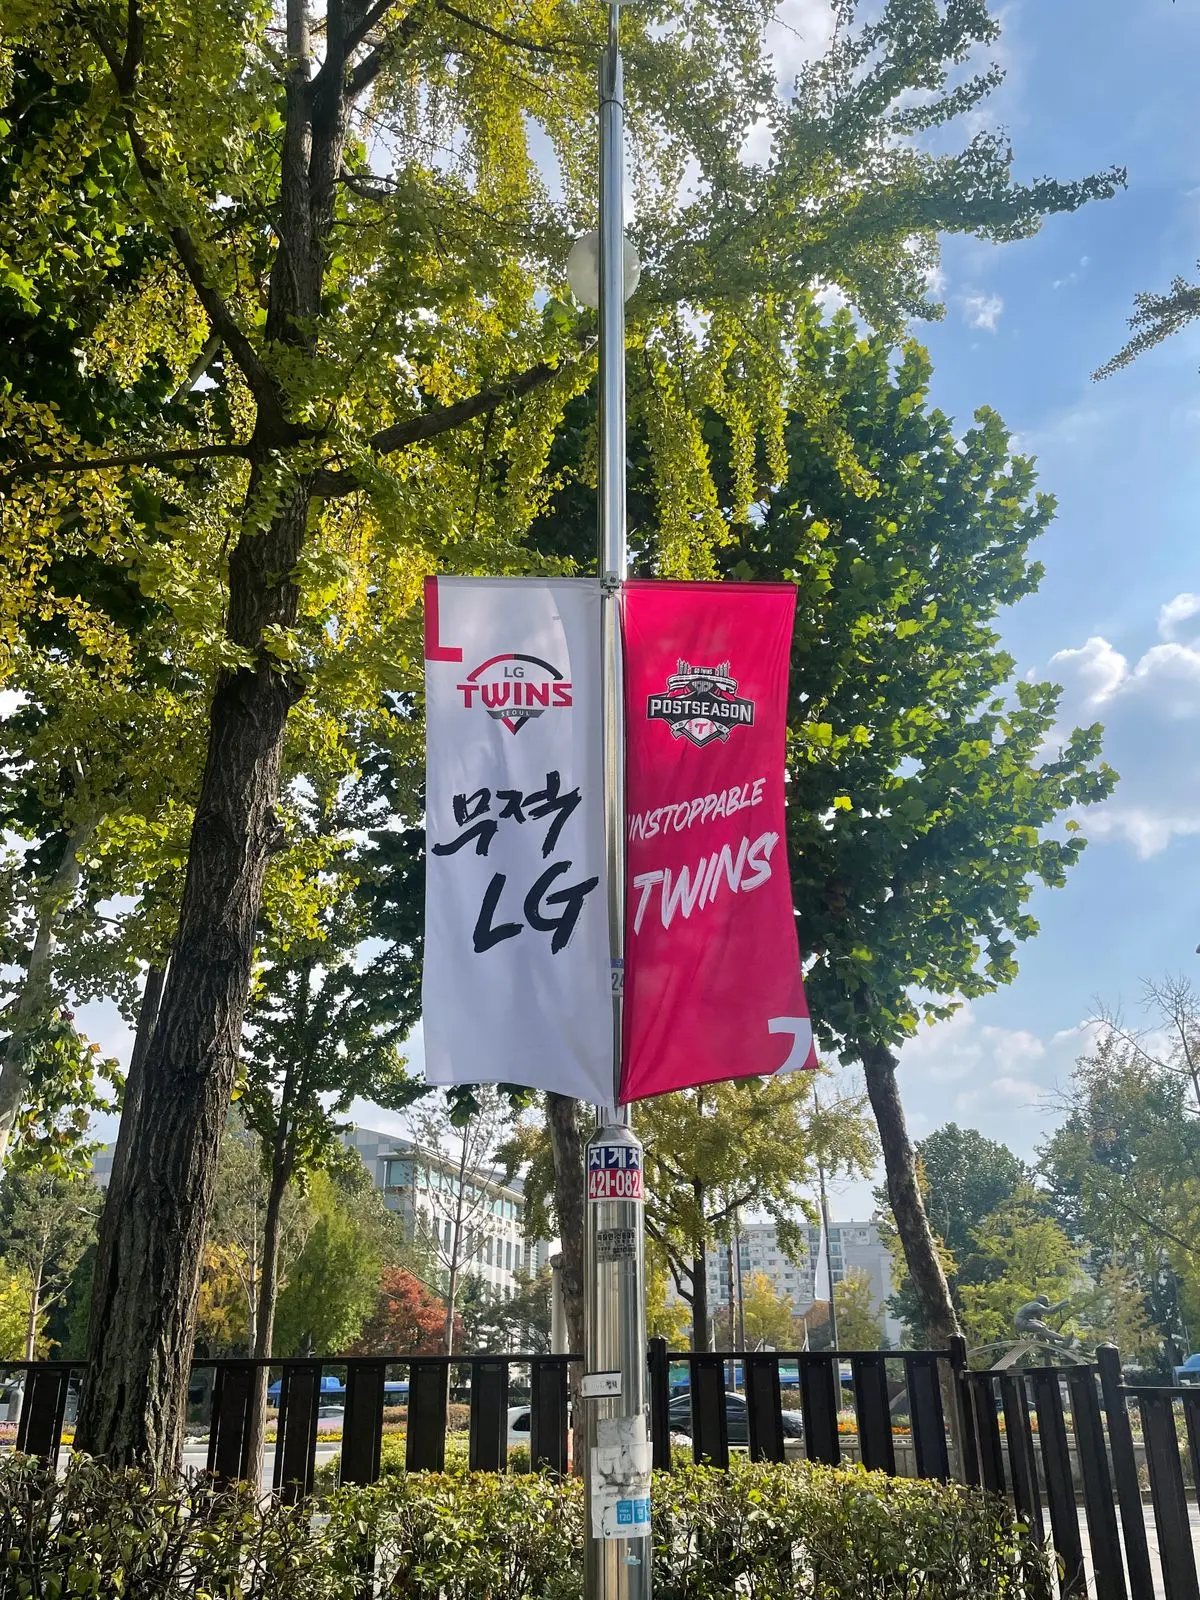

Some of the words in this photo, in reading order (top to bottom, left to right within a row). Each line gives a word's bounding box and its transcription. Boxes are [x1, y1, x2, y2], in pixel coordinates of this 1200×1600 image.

[504, 667, 525, 678] LG
[456, 682, 573, 708] TWINS
[501, 709, 530, 717] SEOUL
[650, 699, 752, 722] POSTSEASON
[431, 770, 582, 859] 무적
[633, 831, 779, 936] TWINS
[473, 860, 599, 954] LG
[590, 1170, 643, 1197] 421-082
